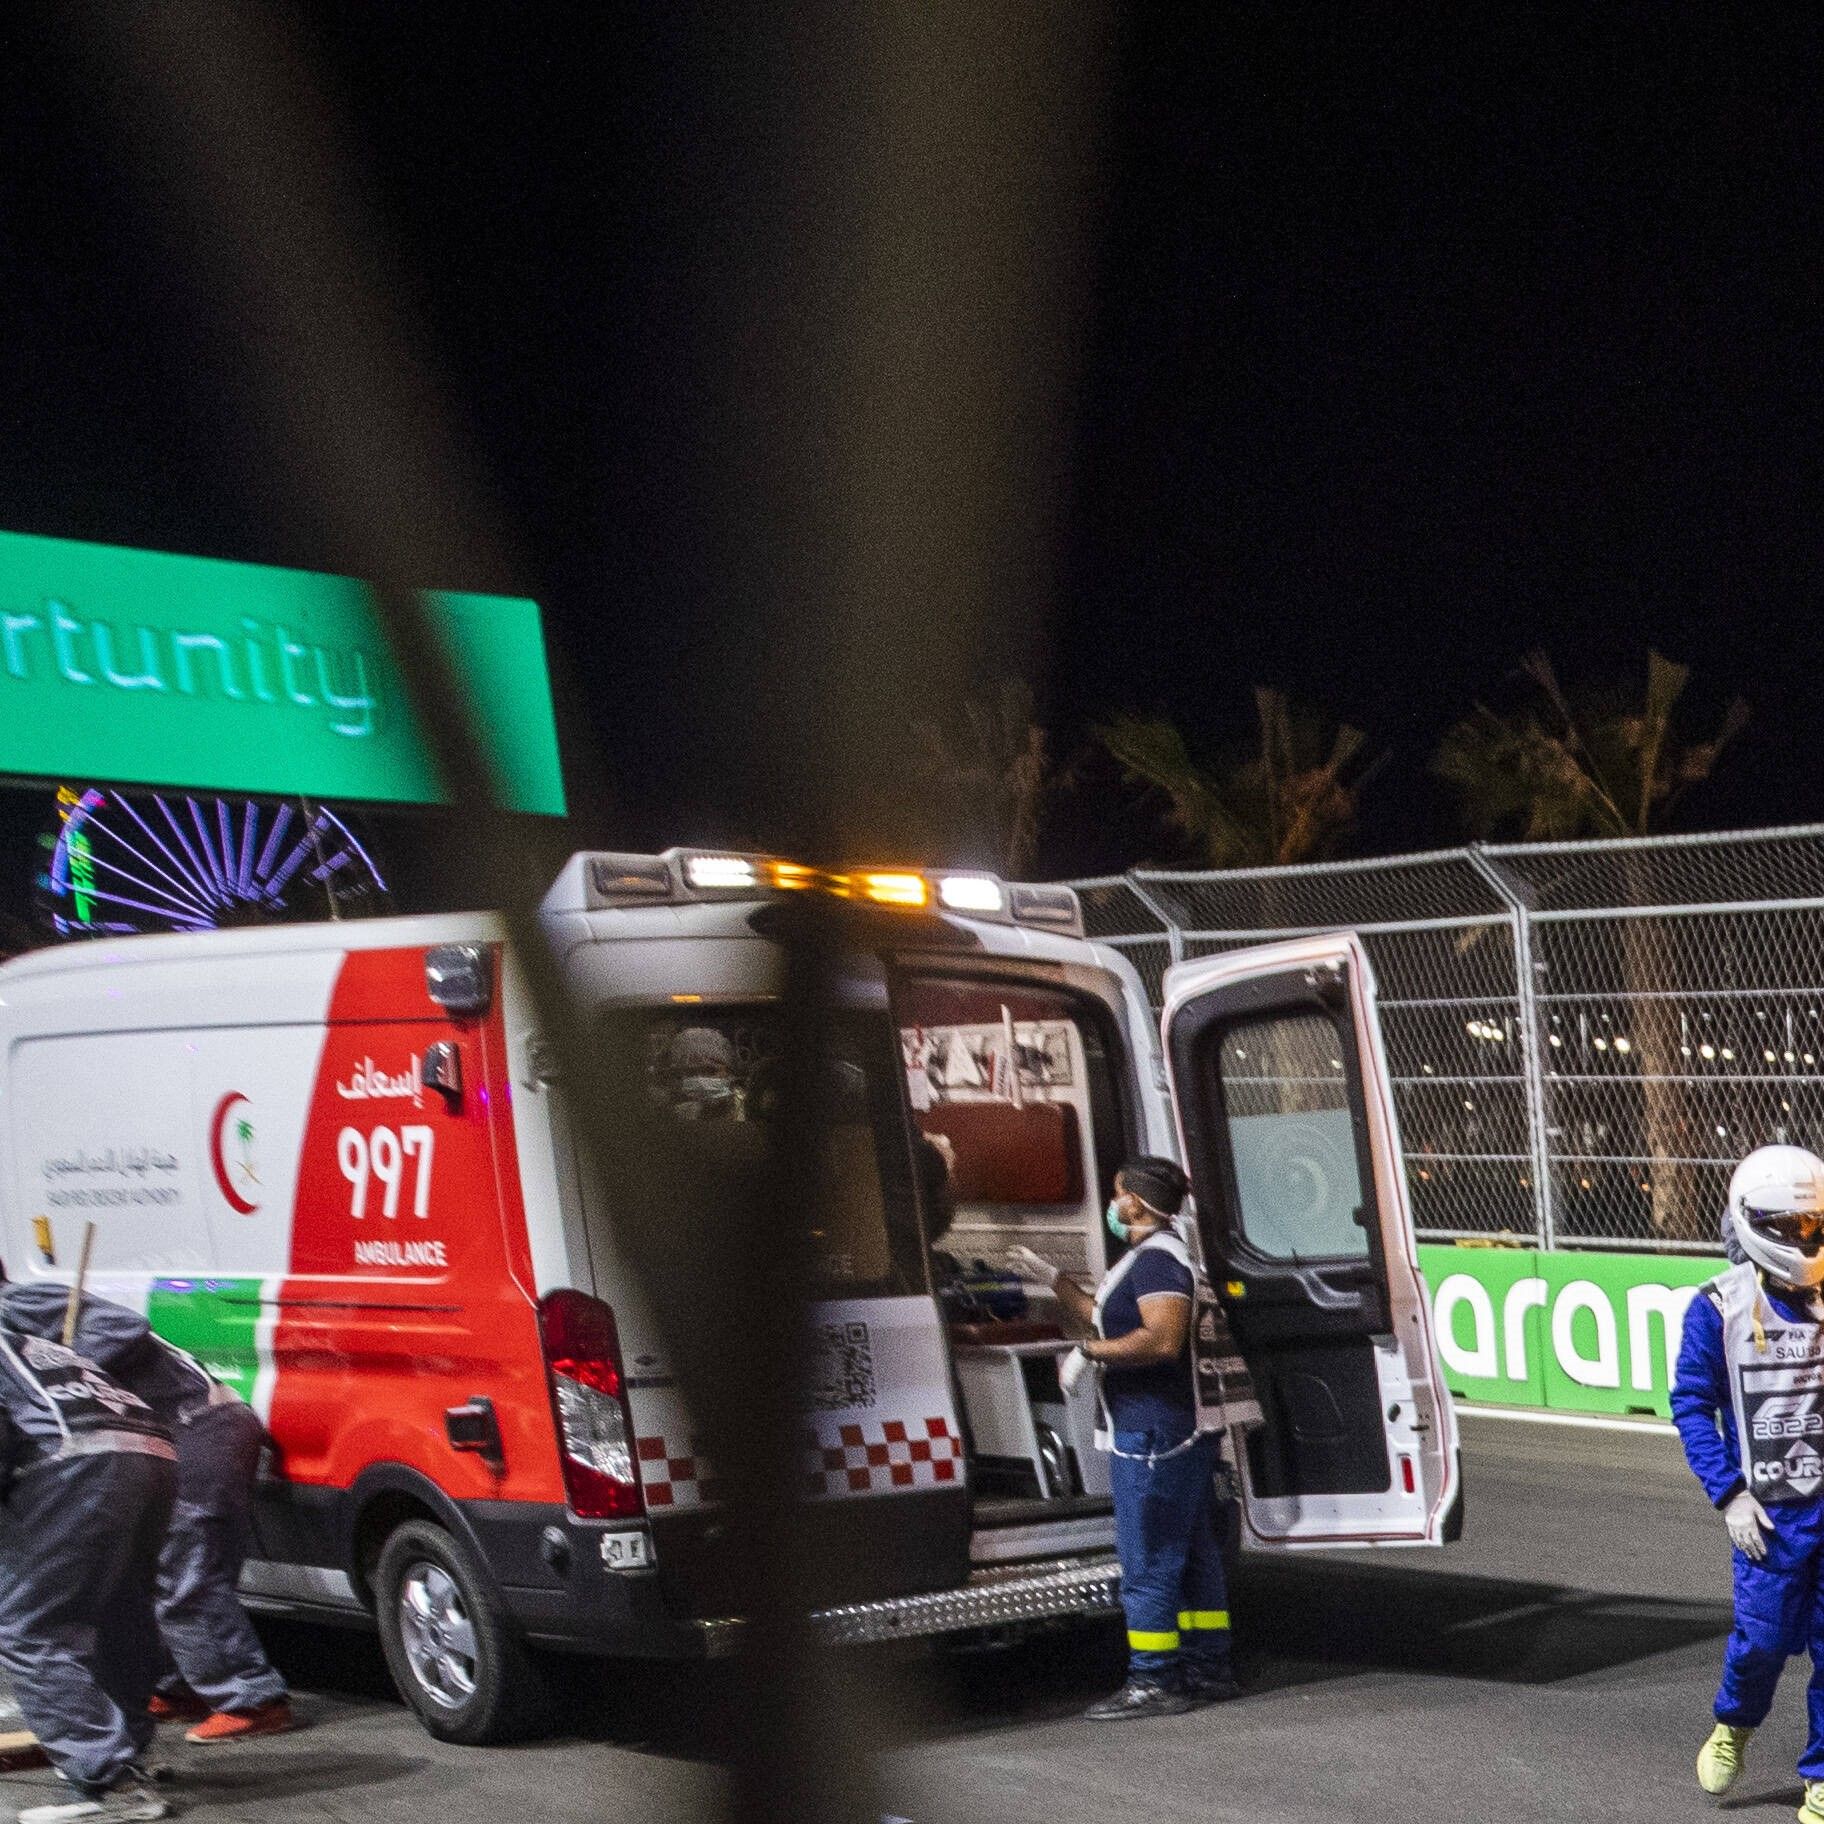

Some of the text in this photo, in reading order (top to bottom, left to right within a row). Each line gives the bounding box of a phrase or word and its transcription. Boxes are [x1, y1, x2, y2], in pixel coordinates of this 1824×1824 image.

[336, 1123, 434, 1220] 997
[354, 1240, 448, 1267] AMBULANCE
[1752, 1413, 1824, 1440] 2022
